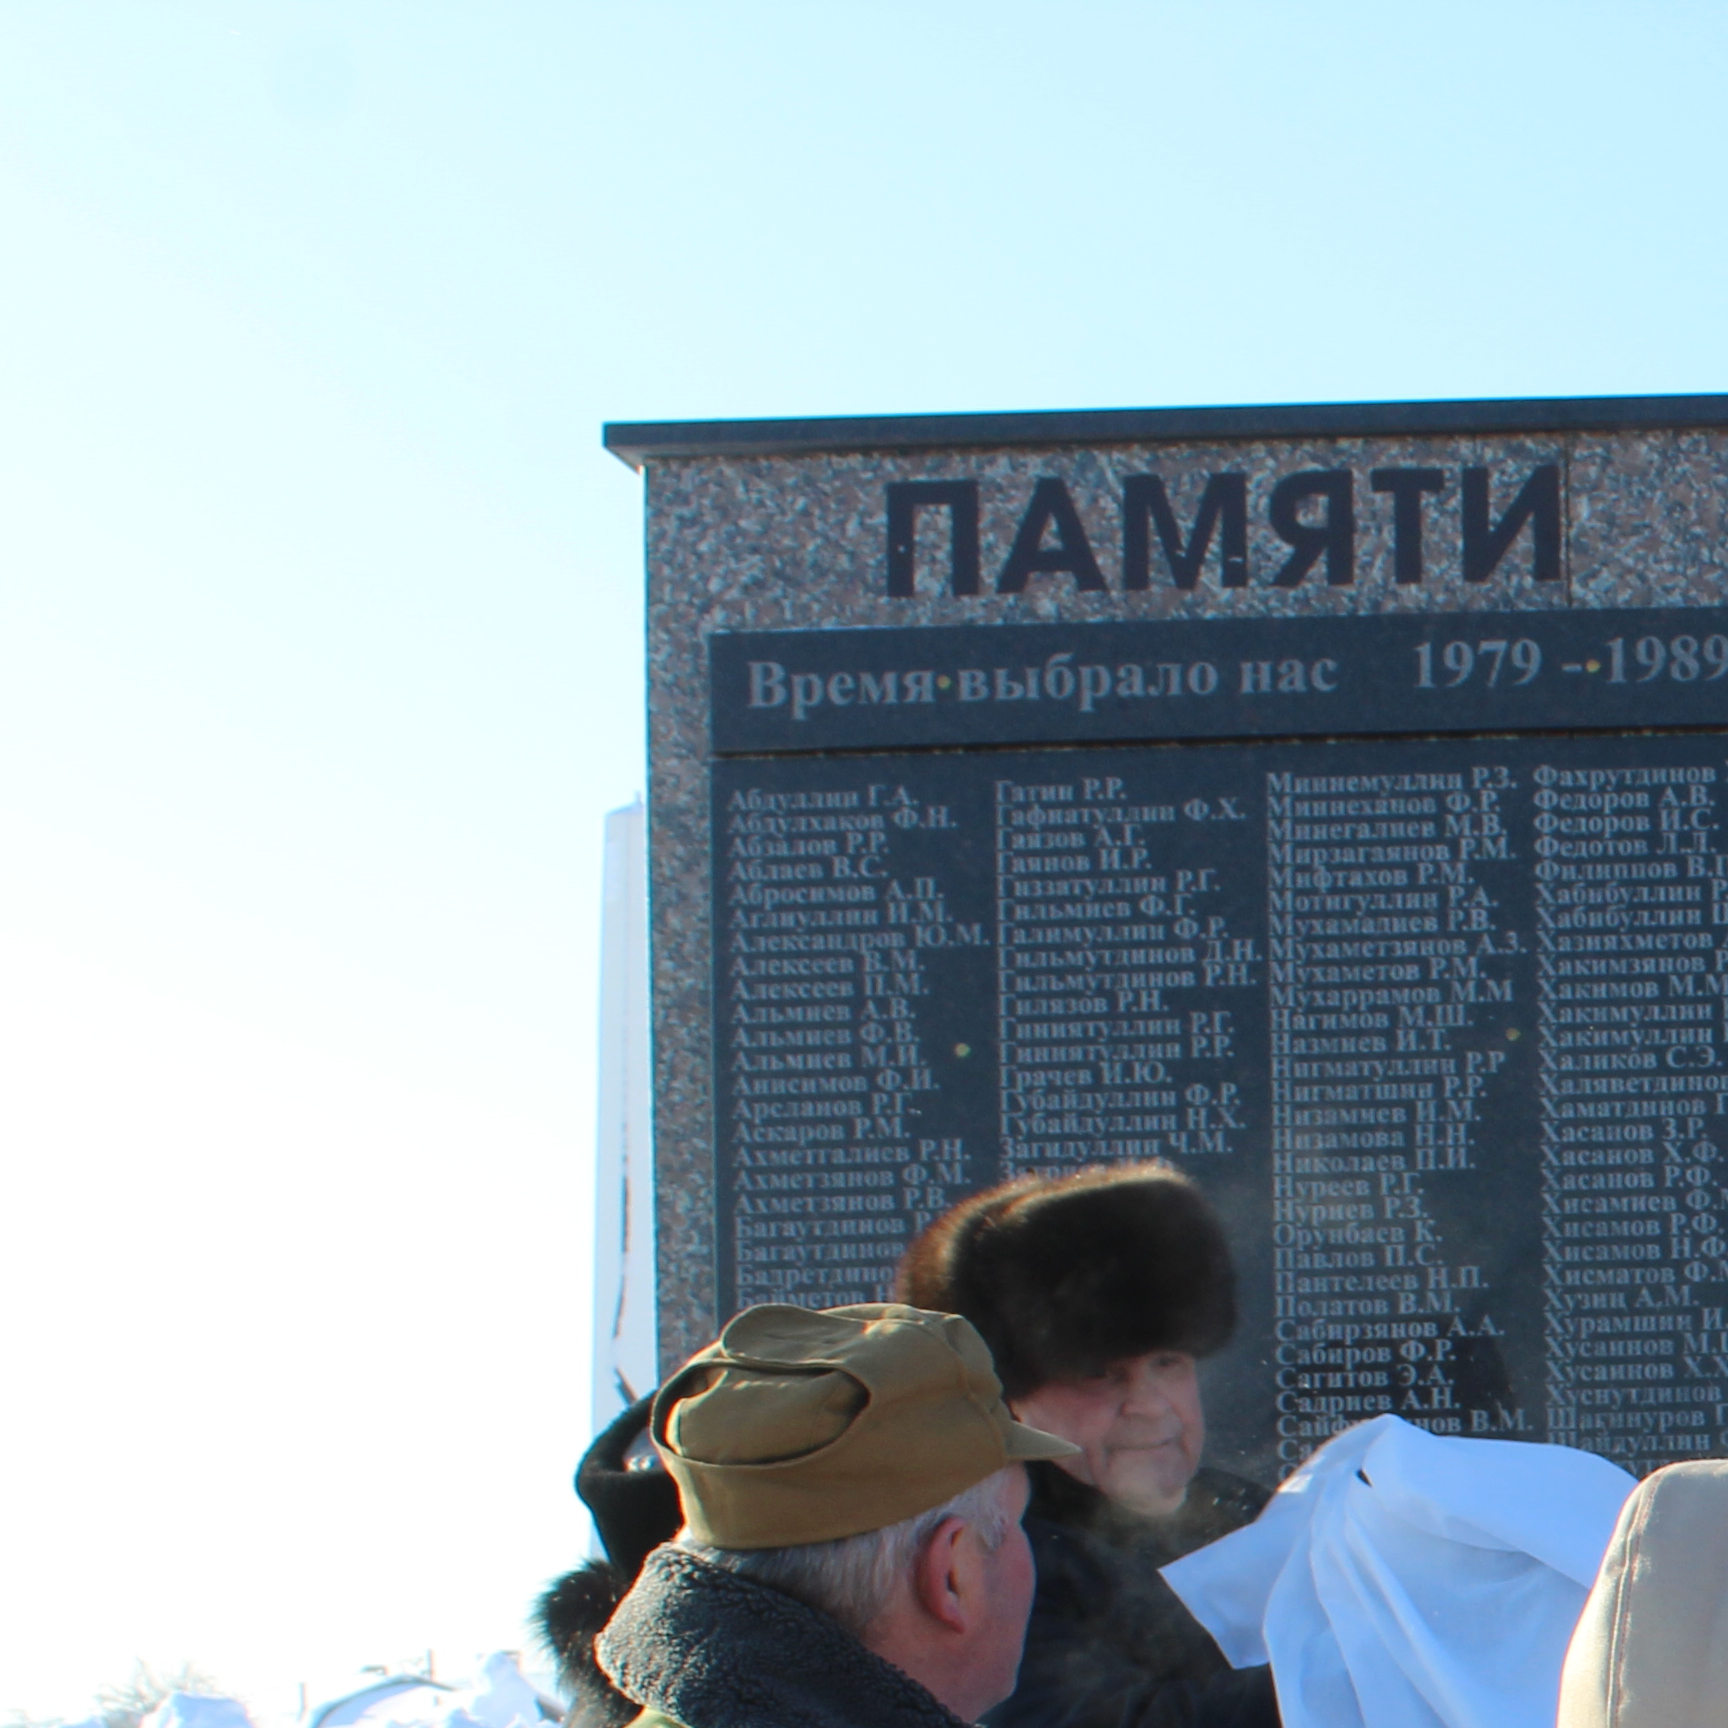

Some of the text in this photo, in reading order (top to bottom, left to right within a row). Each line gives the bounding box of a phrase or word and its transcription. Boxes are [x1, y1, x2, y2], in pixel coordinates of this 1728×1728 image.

[882, 464, 1563, 599] ПАМЯТИ
[748, 661, 935, 720] Время
[959, 652, 1219, 713] выбрало
[1240, 656, 1339, 694] нас
[1413, 638, 1542, 688] 1979
